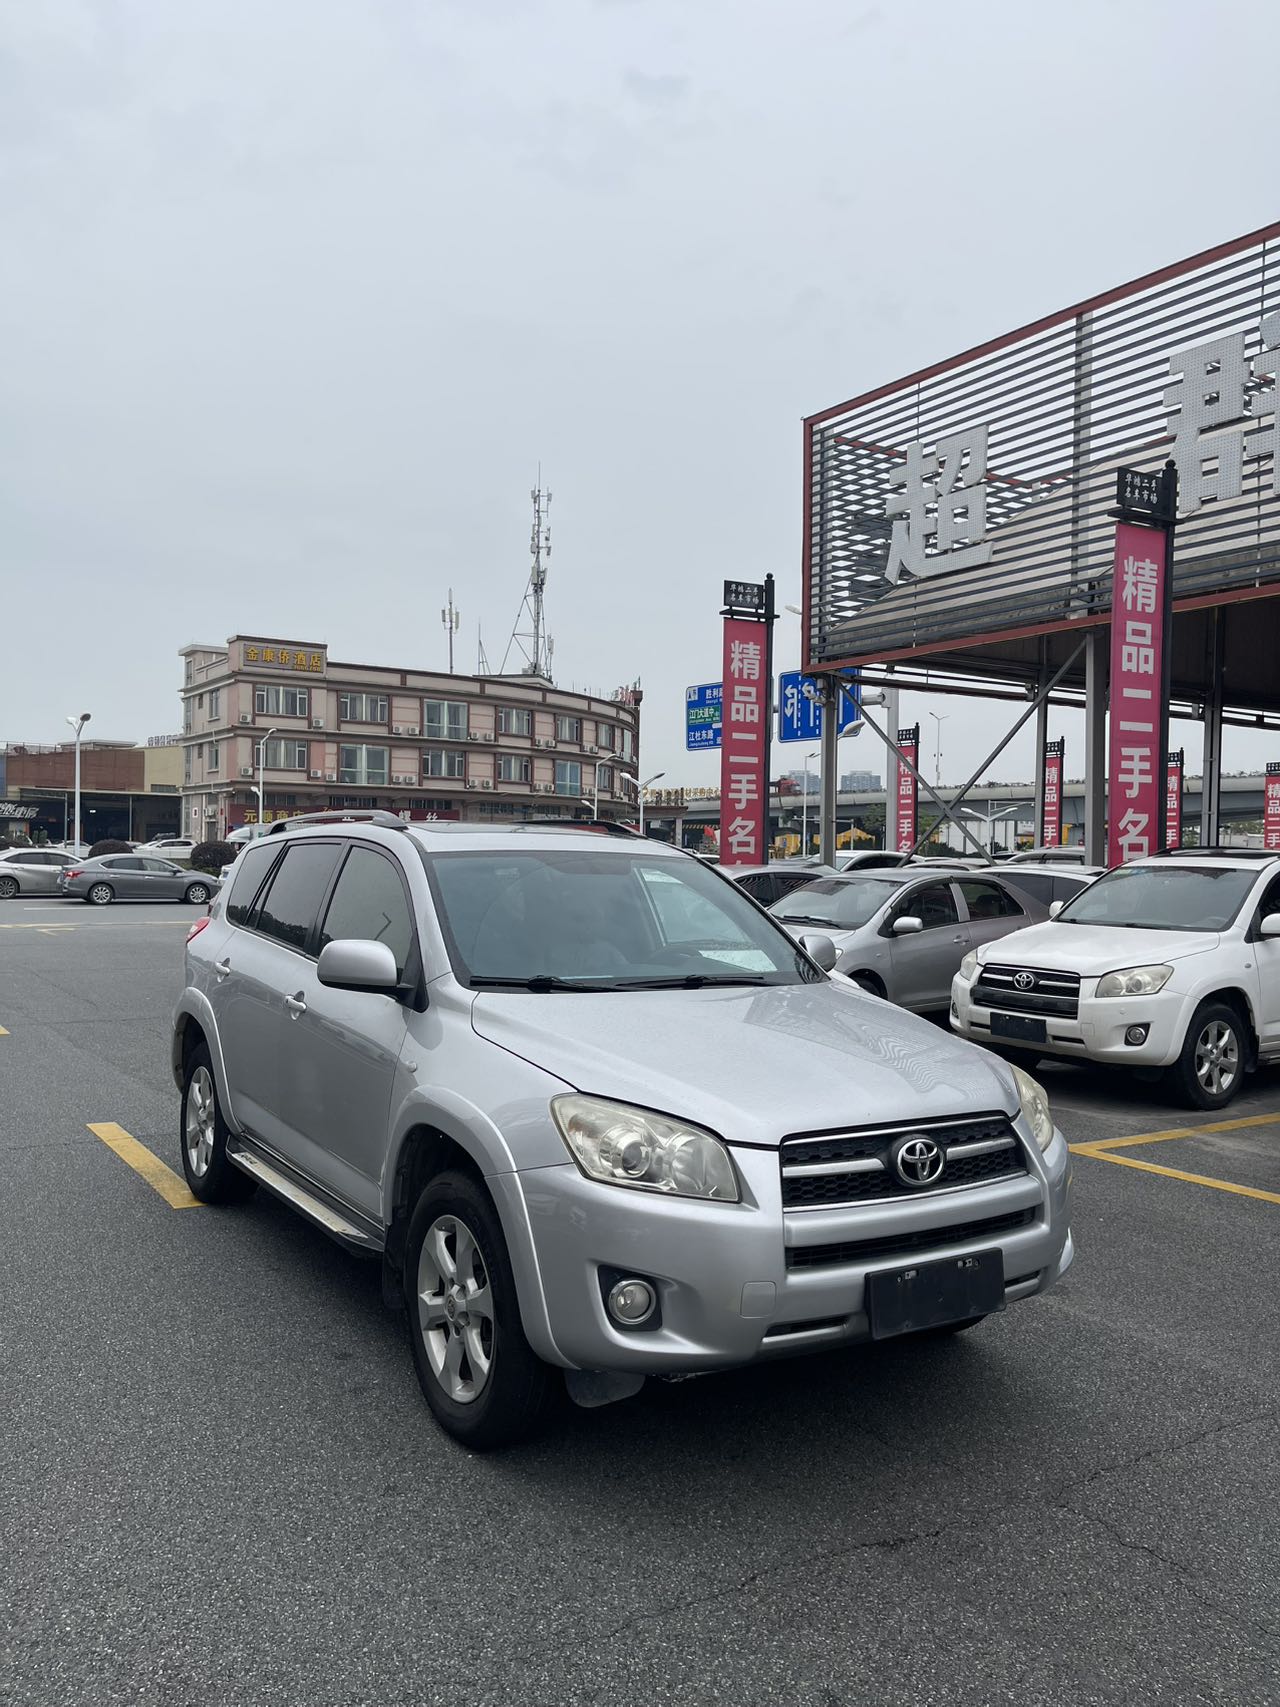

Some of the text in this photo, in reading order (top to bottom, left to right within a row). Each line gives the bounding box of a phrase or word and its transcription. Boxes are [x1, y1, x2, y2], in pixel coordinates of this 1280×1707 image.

[246, 646, 321, 667] 金康侨酒店
[728, 640, 761, 864] 精品二手名
[1044, 766, 1058, 848] 精品二手
